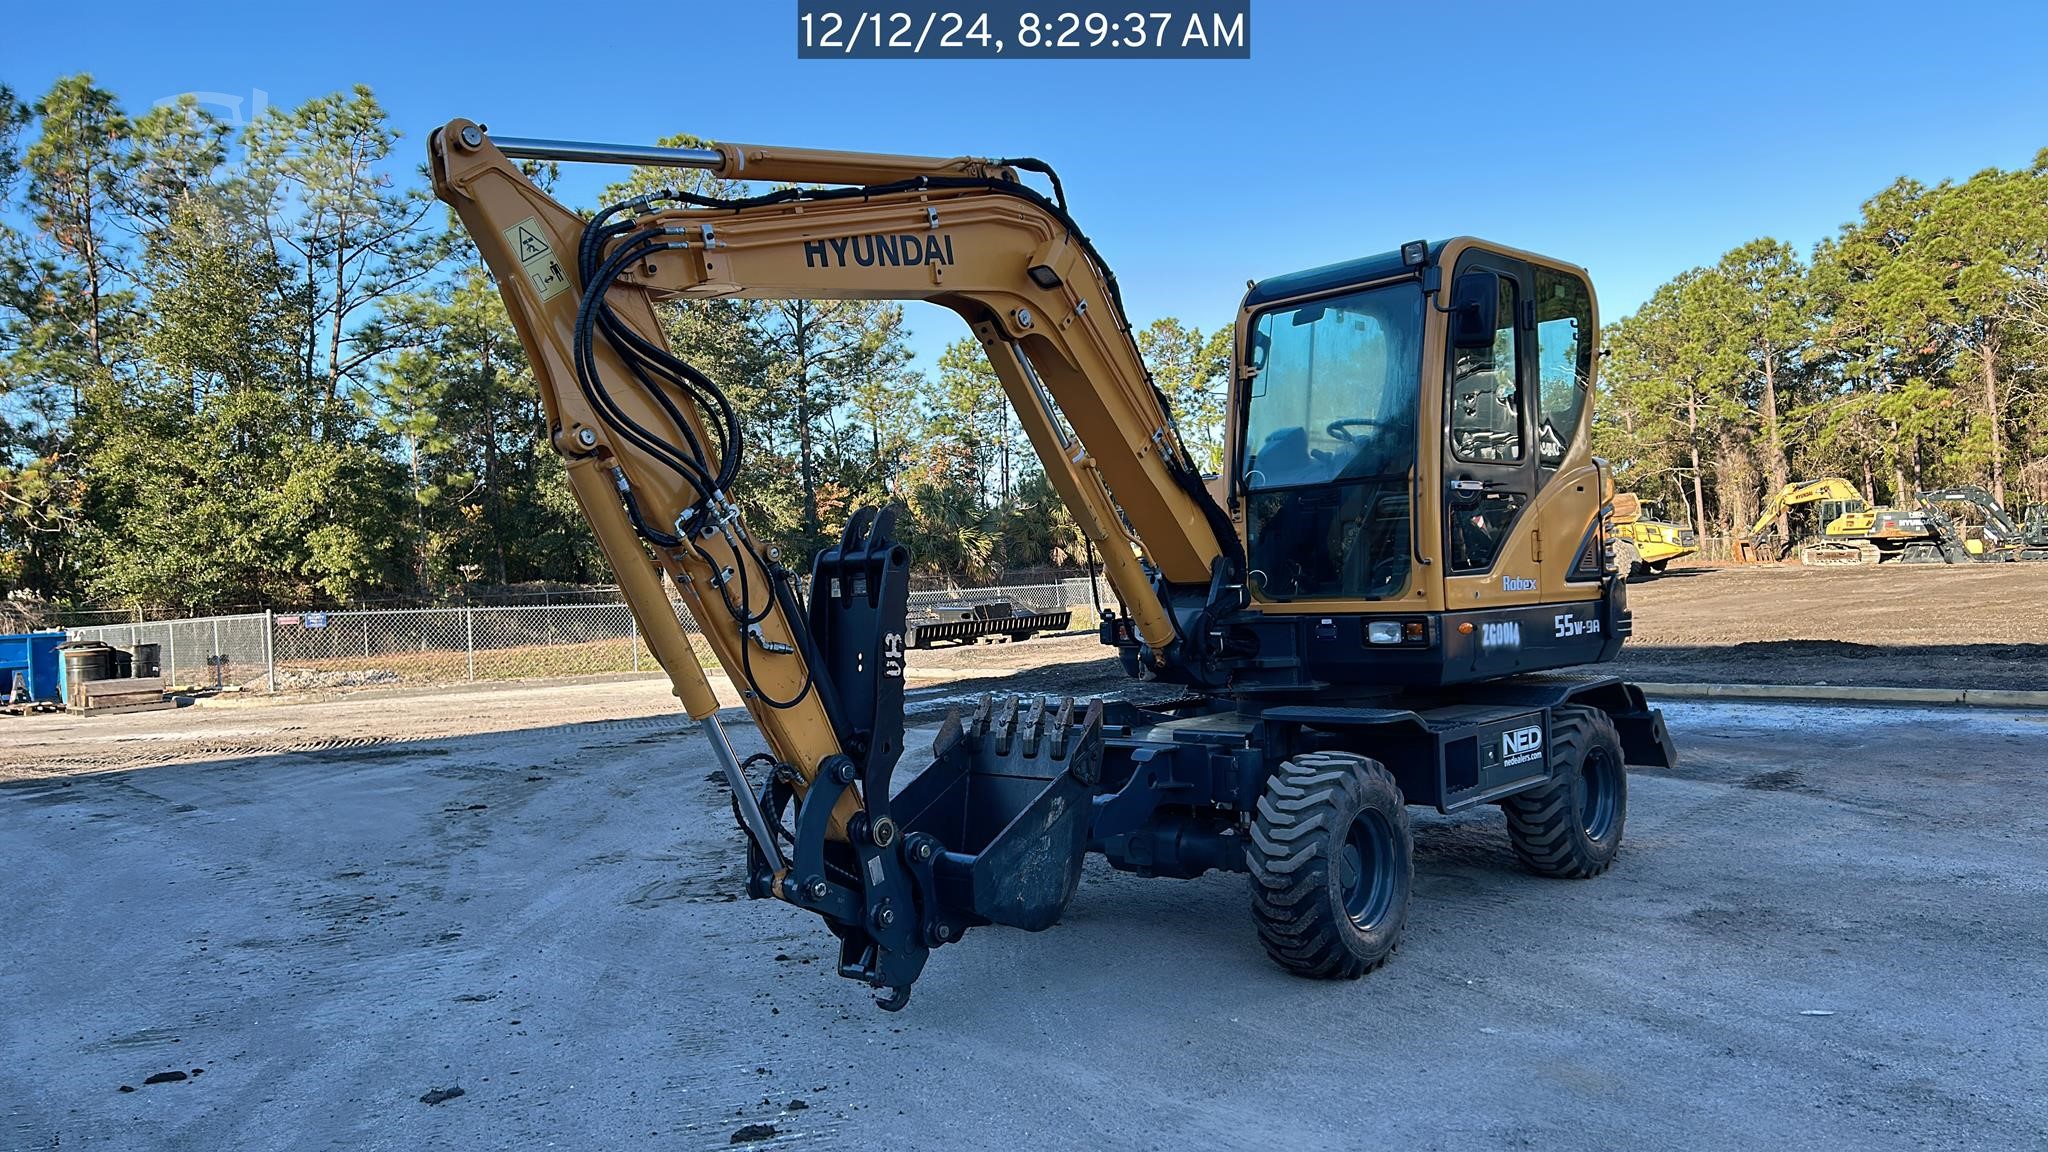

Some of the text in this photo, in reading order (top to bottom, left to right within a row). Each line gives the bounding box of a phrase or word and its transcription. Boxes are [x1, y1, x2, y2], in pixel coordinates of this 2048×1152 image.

[804, 234, 955, 268] HYUNDAI
[1503, 575, 1537, 592] Robex
[1503, 727, 1542, 756] NED
[1504, 751, 1543, 768] nedealers.com
